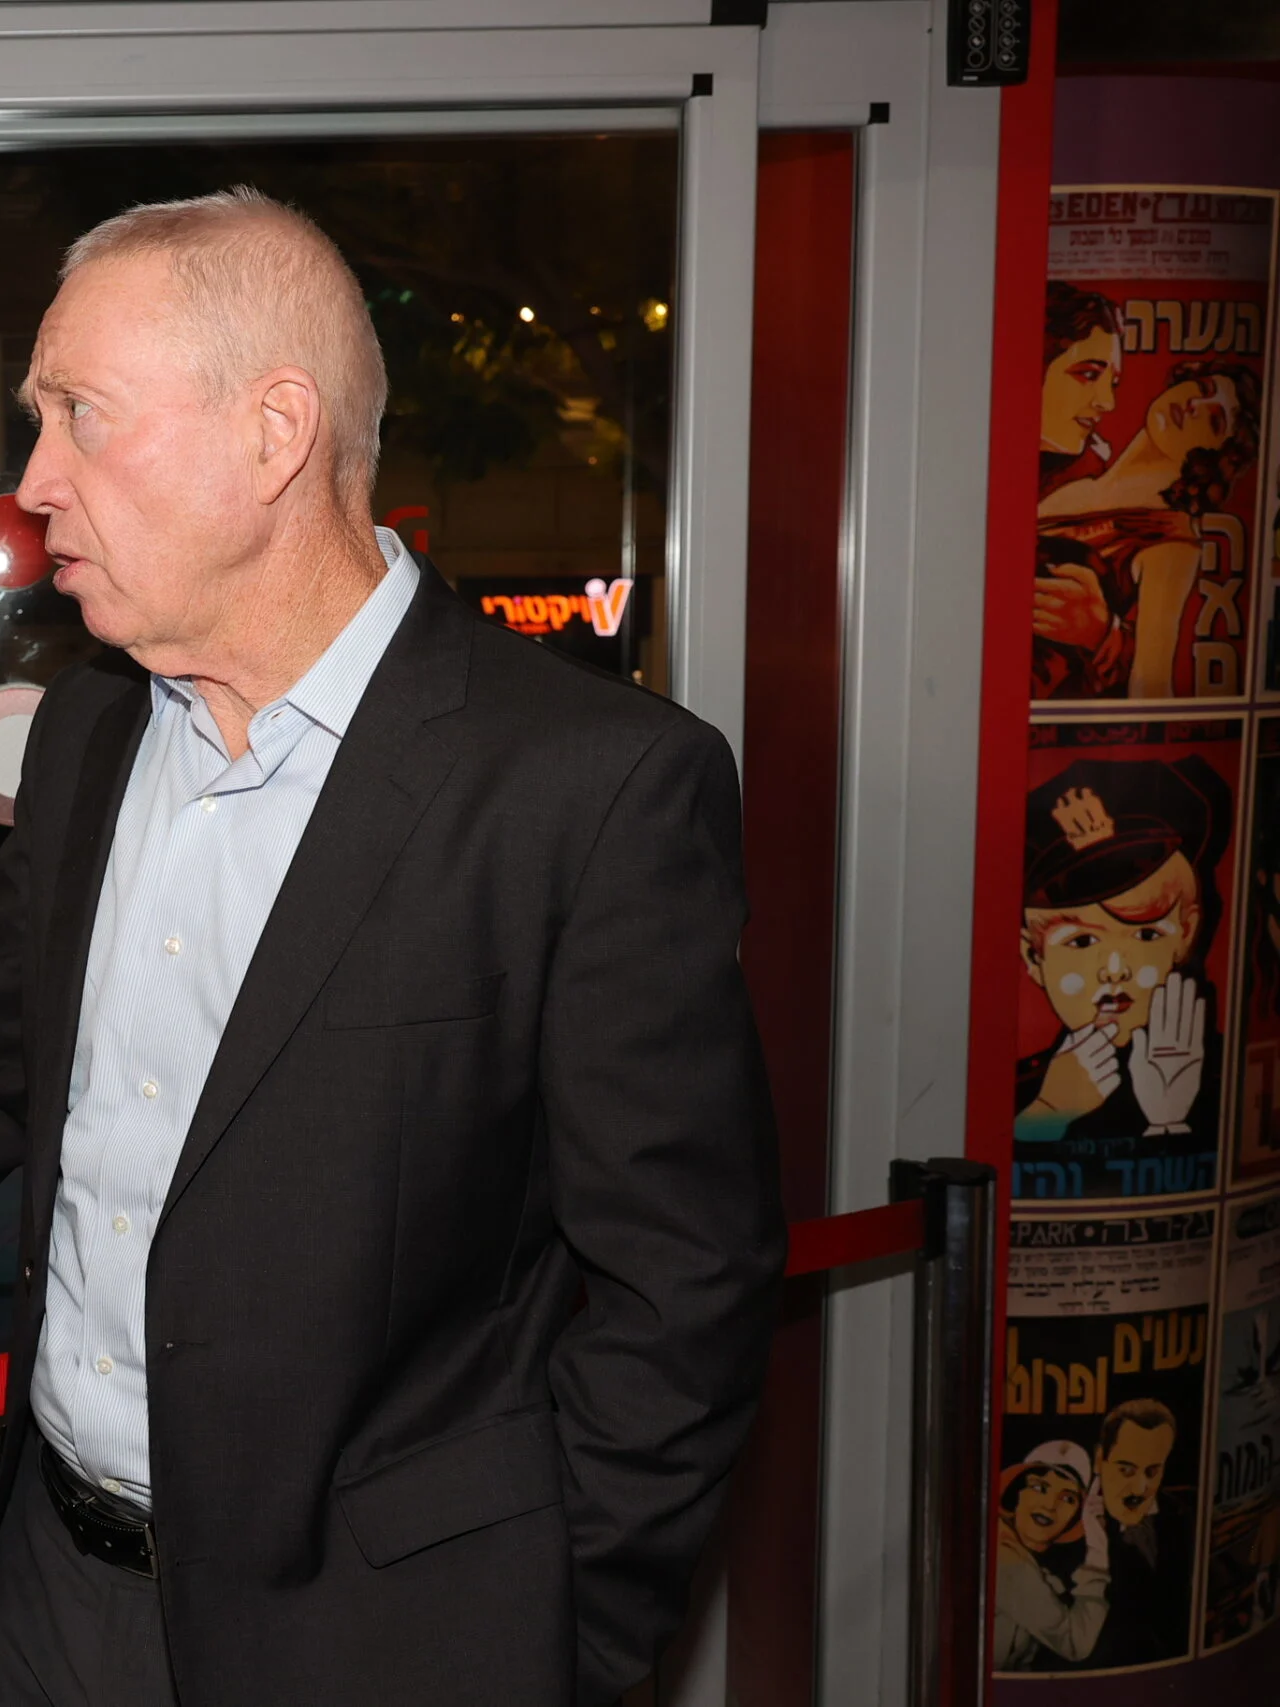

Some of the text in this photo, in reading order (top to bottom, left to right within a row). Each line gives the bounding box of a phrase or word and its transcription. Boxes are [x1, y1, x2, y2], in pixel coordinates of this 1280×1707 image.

[1068, 193, 1137, 220] EDEN
[1122, 299, 1262, 353] הנערה
[1113, 1311, 1206, 1373] נשים
